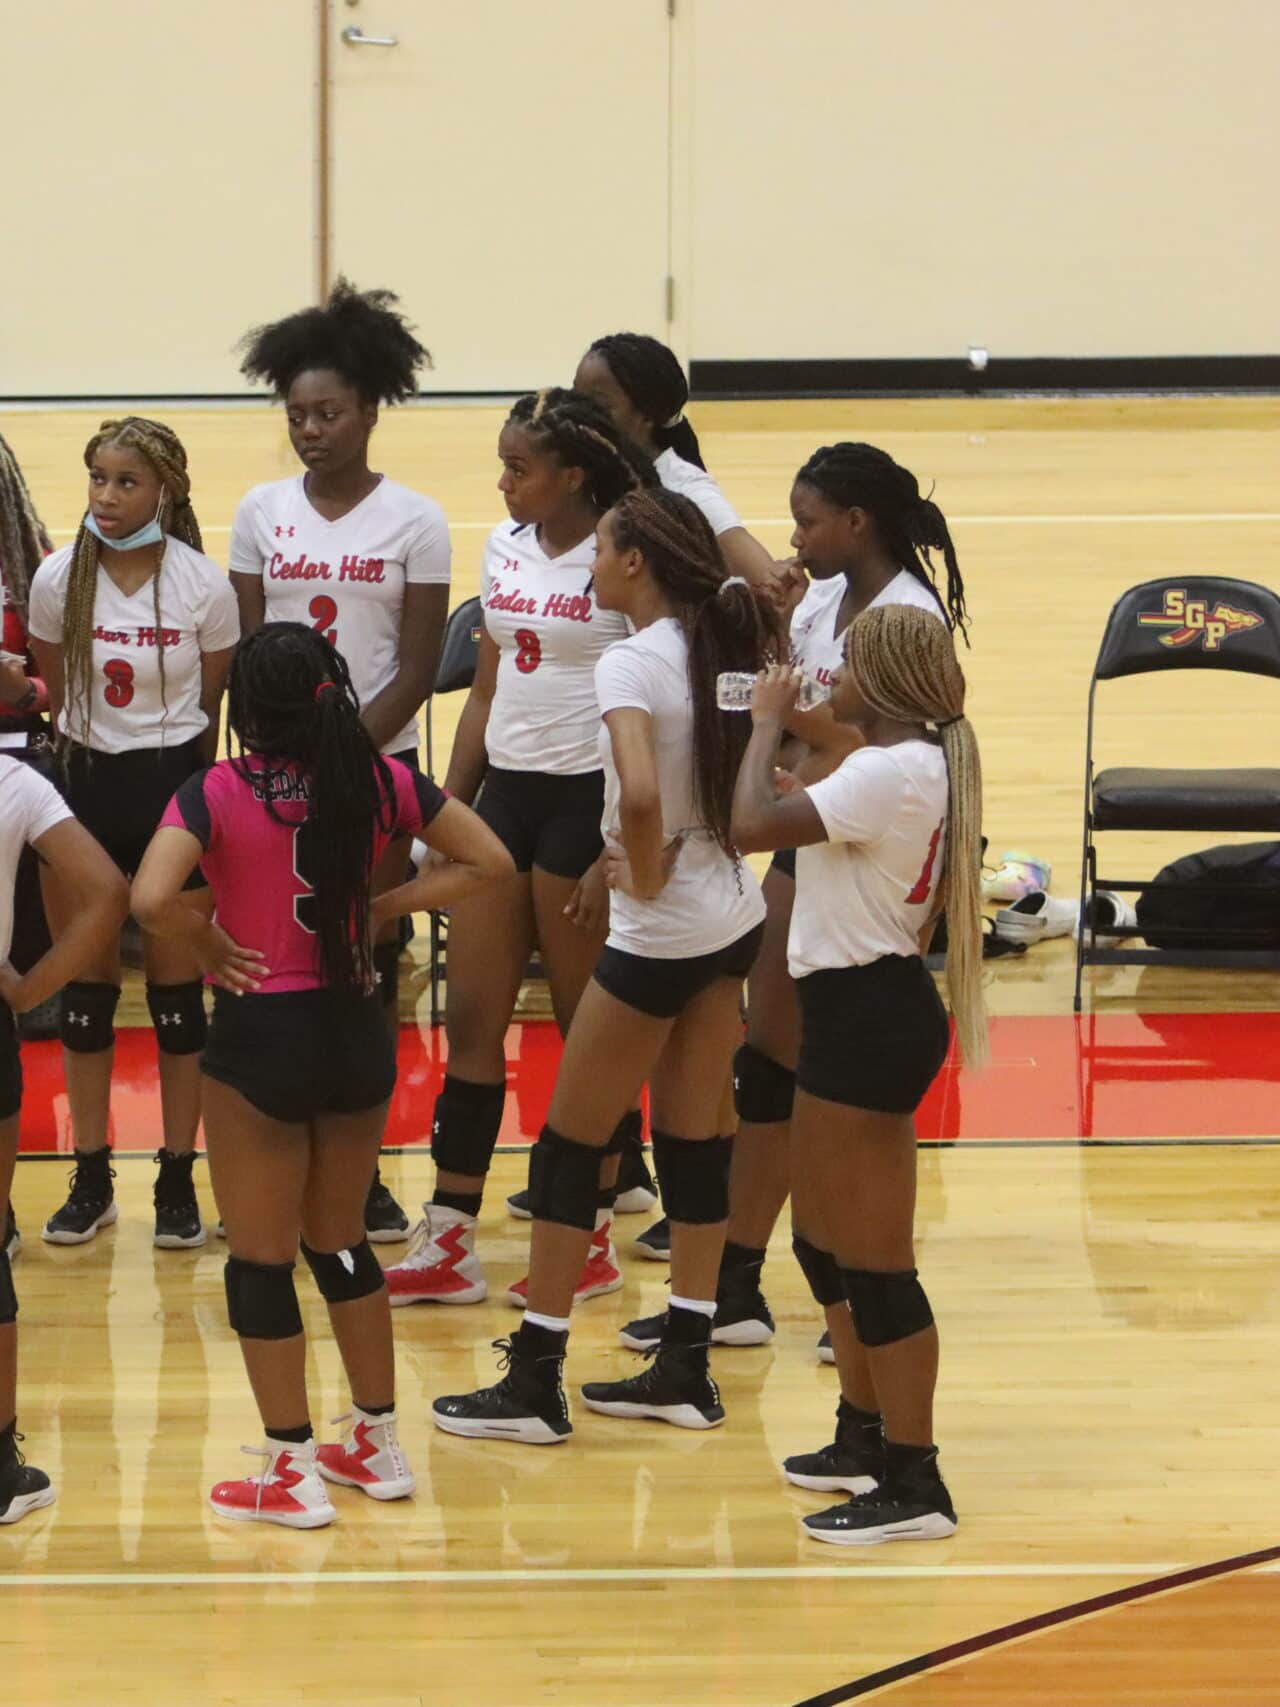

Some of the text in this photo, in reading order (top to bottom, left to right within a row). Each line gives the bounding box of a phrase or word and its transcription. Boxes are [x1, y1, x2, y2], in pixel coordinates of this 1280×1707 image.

[270, 552, 385, 584] Cedar Hill
[541, 593, 593, 623] Hill
[1163, 589, 1226, 652] SGP
[514, 628, 541, 674] 8
[103, 658, 134, 708] 3
